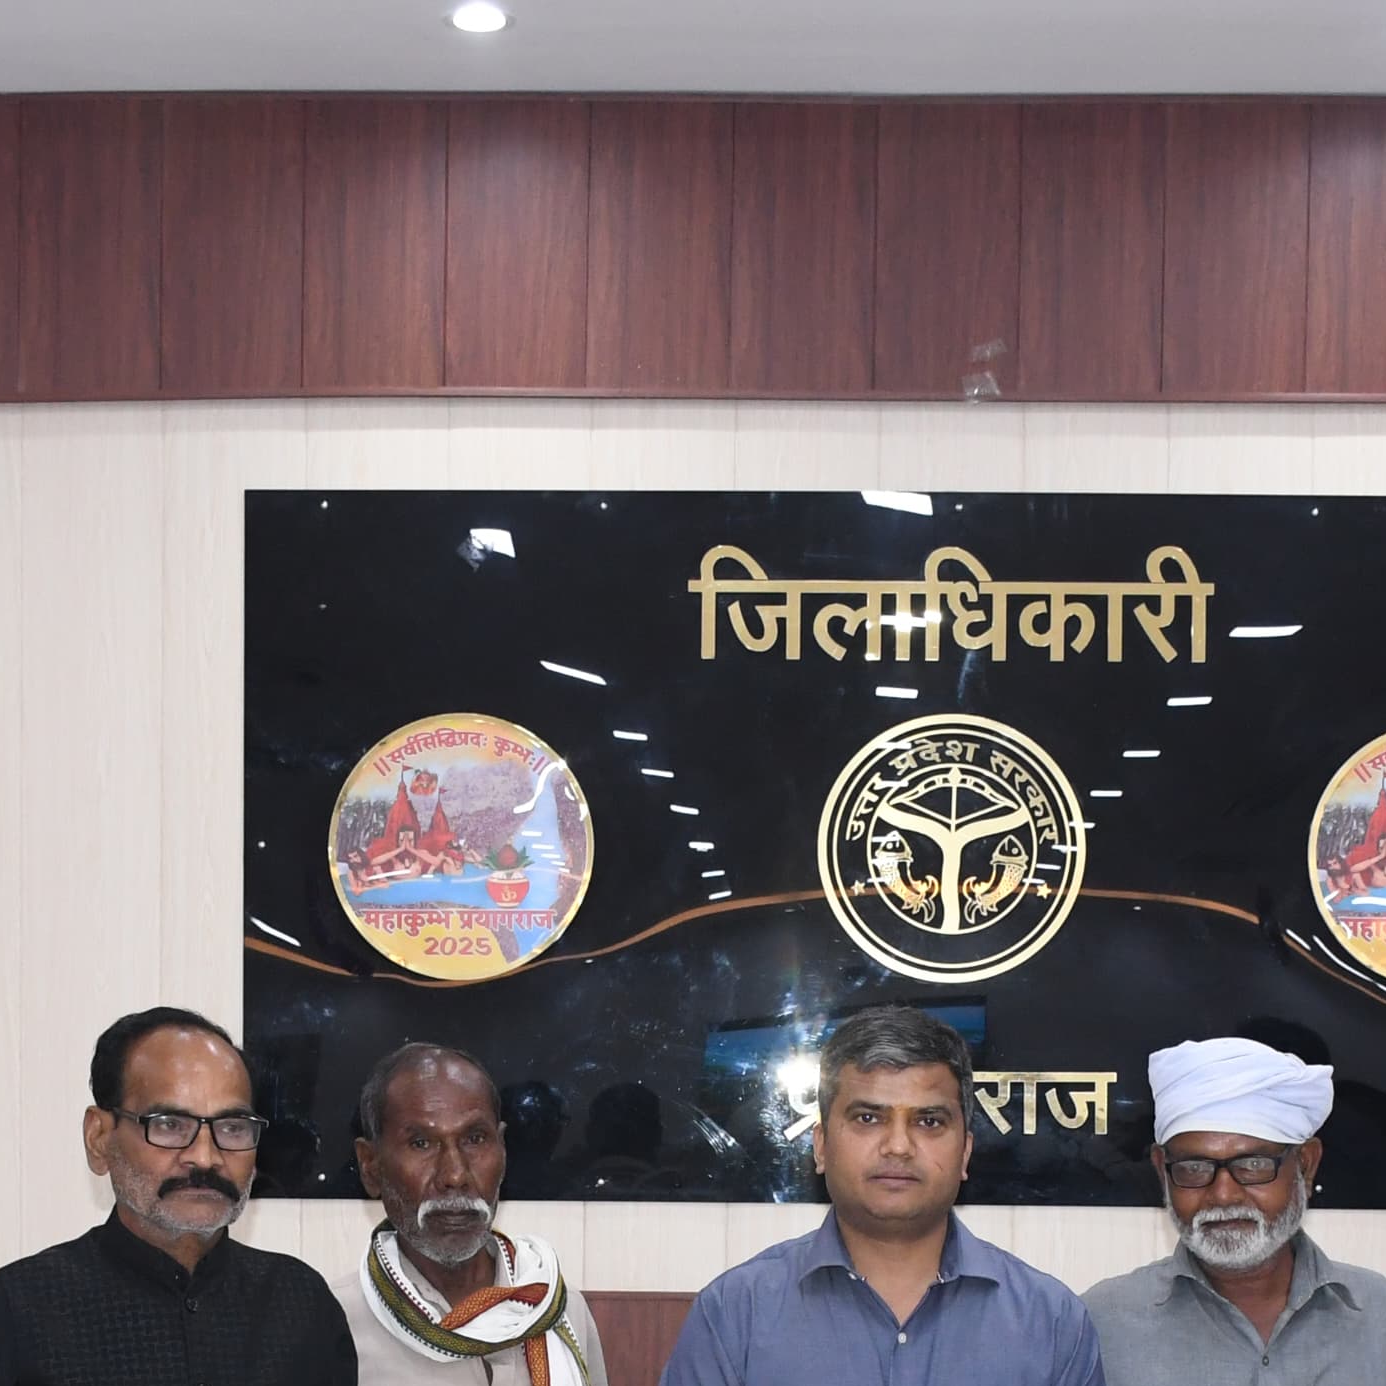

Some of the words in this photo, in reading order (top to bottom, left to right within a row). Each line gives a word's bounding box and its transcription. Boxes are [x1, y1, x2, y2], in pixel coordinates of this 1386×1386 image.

[687, 544, 1215, 662] जिलाधिकारी
[846, 772, 884, 841] उत्तर
[888, 738, 980, 776] प्रदेश
[990, 750, 1059, 844] सरकार
[363, 908, 451, 936] महाकुम्भ
[456, 908, 557, 932] प्रयागराज
[423, 936, 493, 956] 2025
